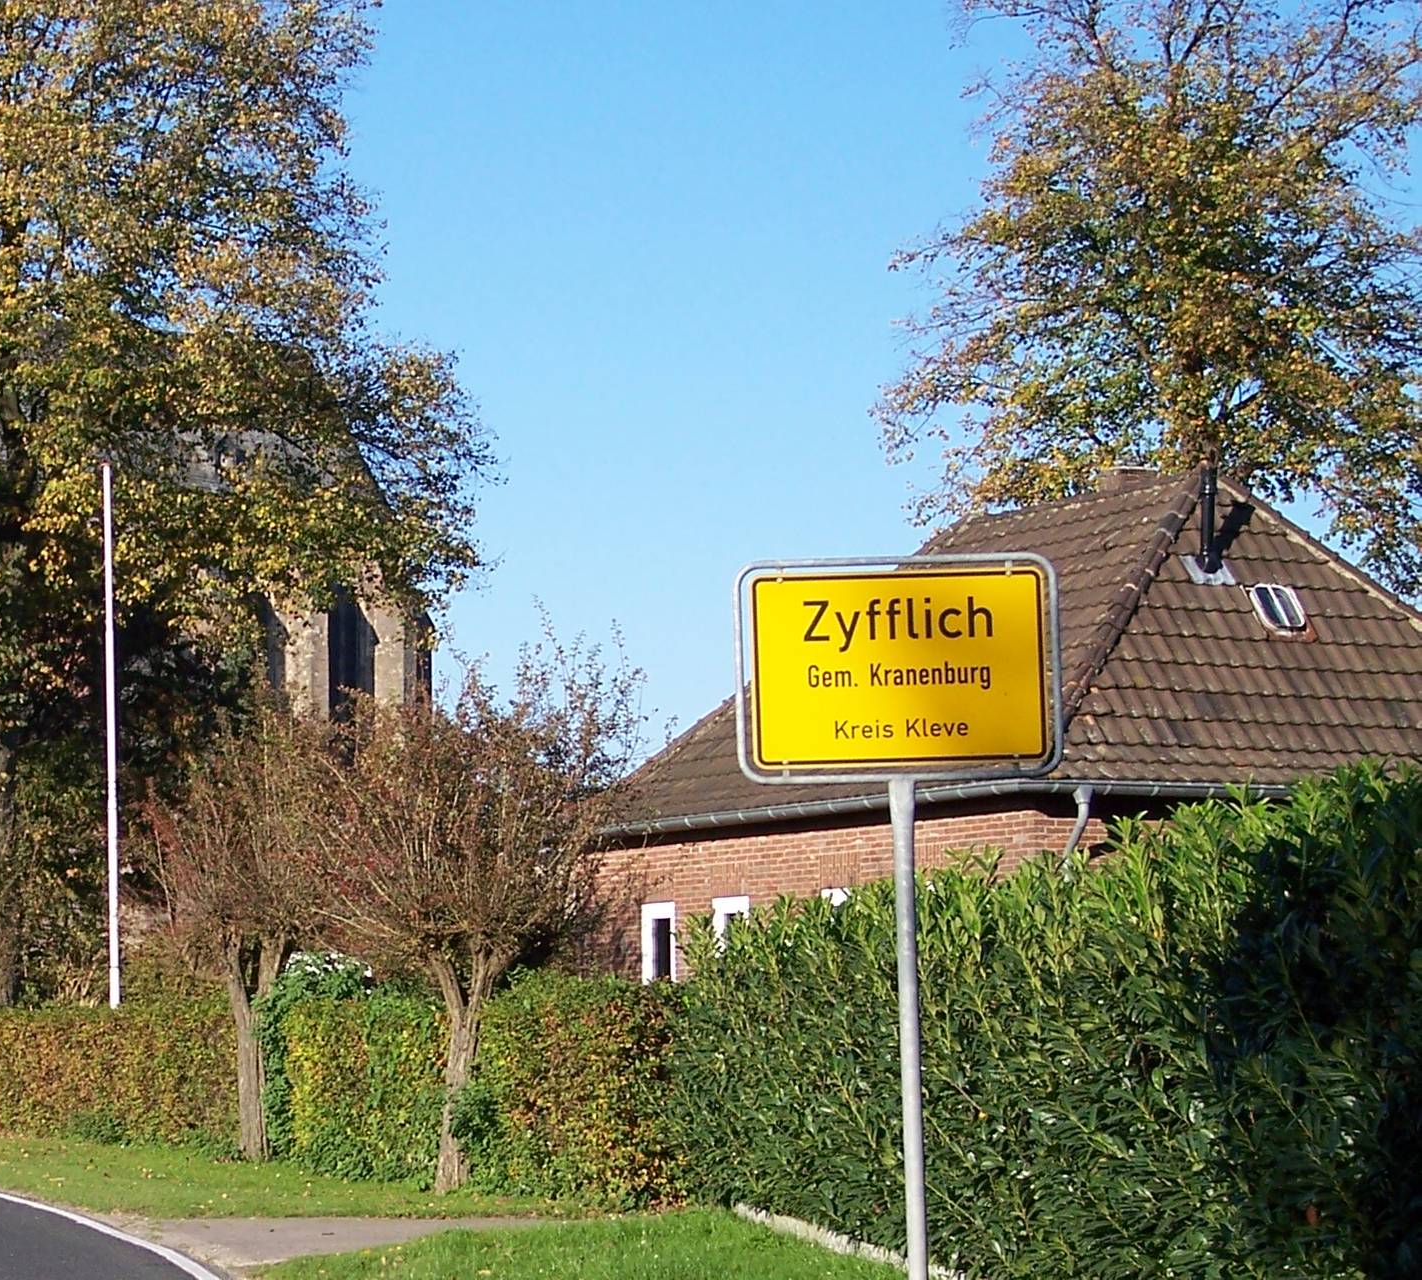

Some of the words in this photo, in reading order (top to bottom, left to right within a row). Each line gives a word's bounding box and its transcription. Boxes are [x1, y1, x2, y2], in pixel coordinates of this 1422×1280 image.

[803, 596, 993, 652] Zyfflich
[808, 665, 859, 688] Gem.
[870, 661, 991, 690] Kranenburg
[834, 719, 895, 740] Kreis
[905, 718, 969, 738] Kleve
